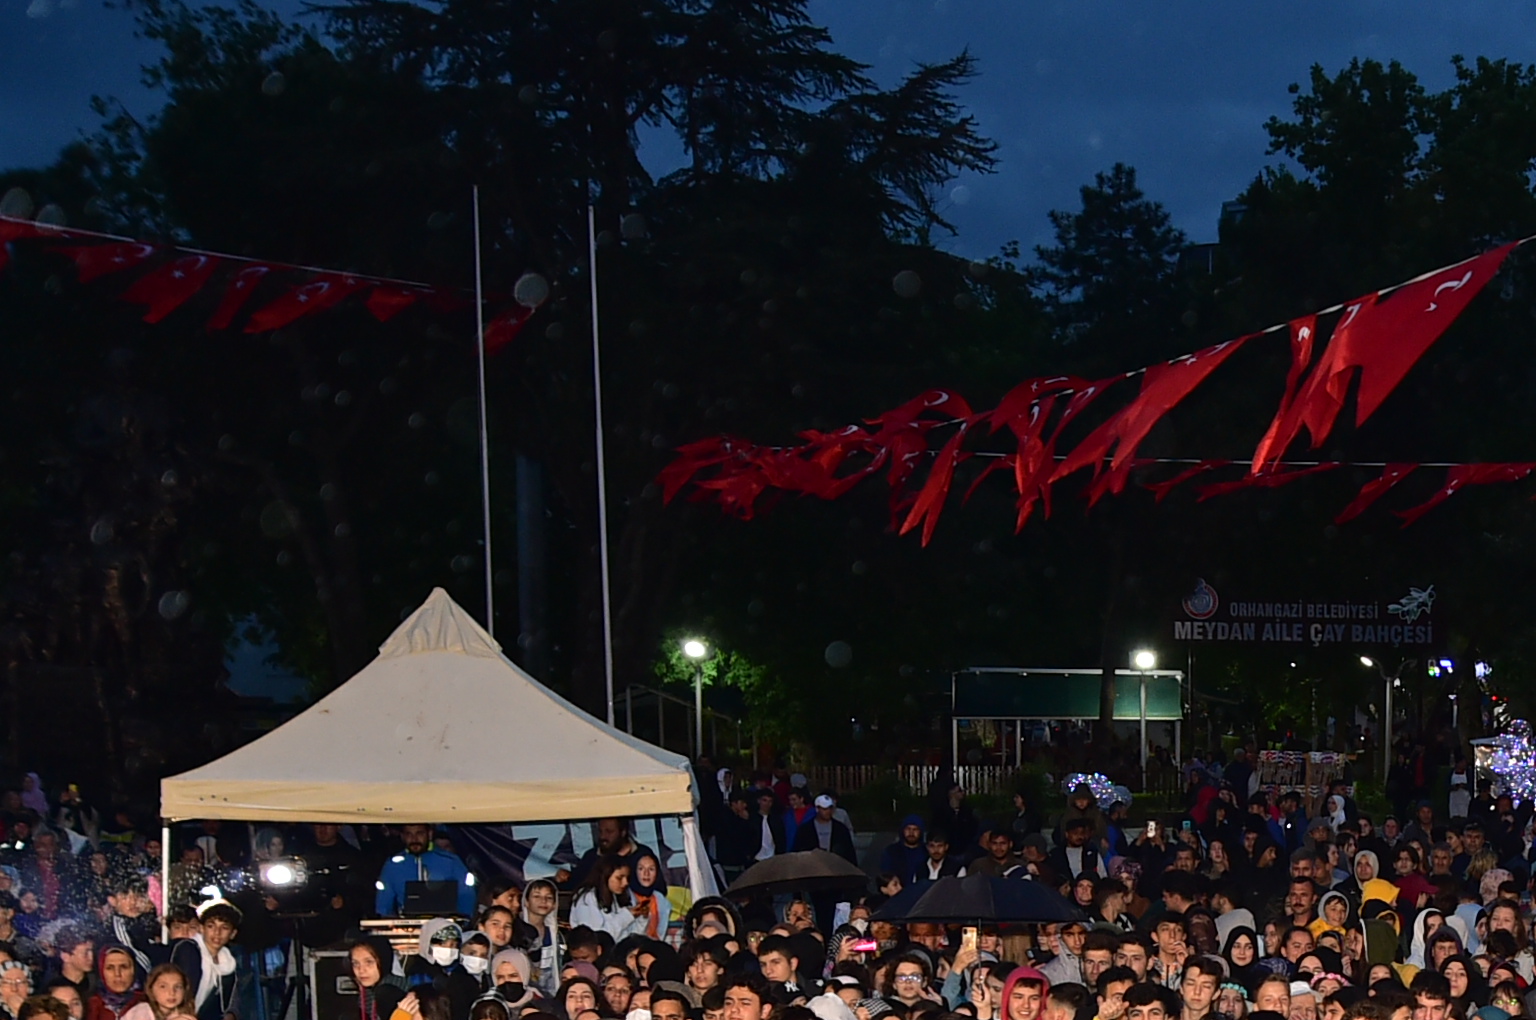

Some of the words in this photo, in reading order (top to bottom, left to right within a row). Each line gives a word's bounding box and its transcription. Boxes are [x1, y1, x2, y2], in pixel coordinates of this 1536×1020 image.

[1230, 599, 1302, 618] ORHANGAZİ
[1307, 600, 1378, 619] BELEDİYESİ
[1174, 621, 1255, 641] MEYDAN
[1262, 619, 1303, 642] AİLE
[1310, 623, 1345, 647] ÇAY
[1352, 621, 1433, 648] BAHÇESİ
